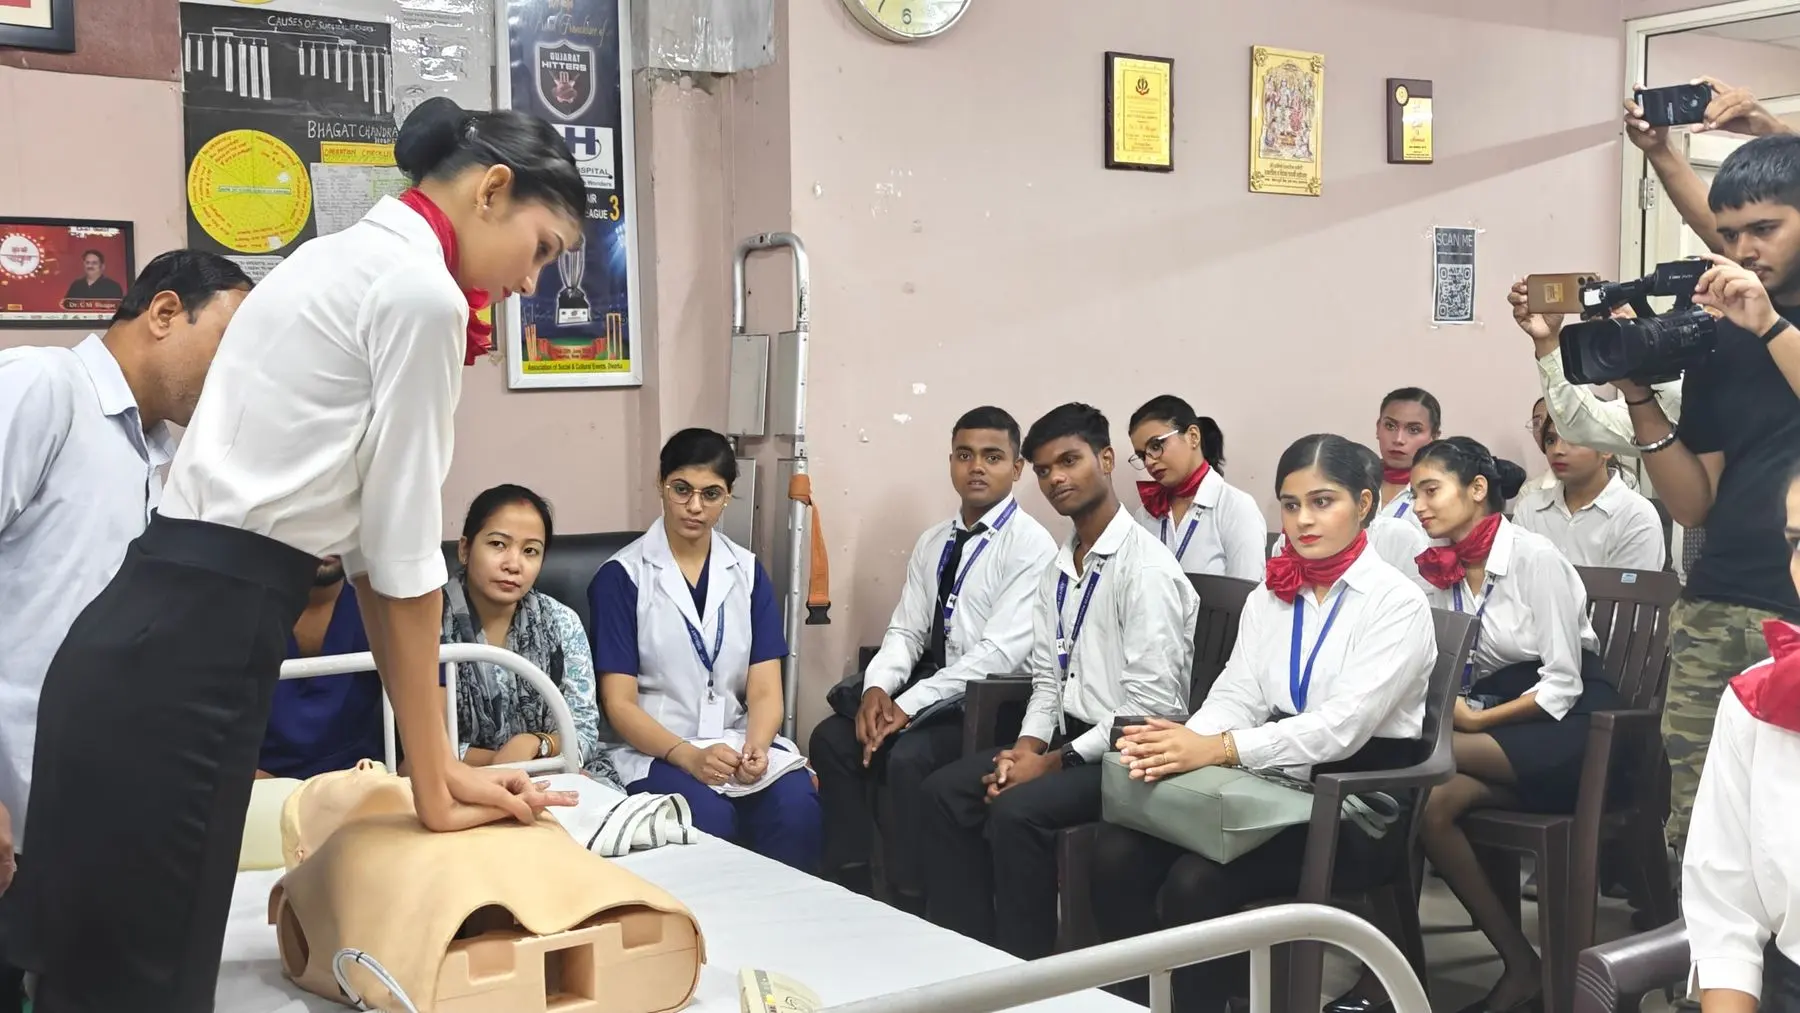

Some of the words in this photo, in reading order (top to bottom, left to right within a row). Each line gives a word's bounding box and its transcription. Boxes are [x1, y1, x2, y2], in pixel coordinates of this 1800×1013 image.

[267, 15, 303, 27] CAUSES
[304, 19, 317, 29] OF
[902, 8, 912, 25] 6
[549, 51, 581, 63] GUJARAT
[541, 60, 587, 72] HITTERS
[308, 120, 357, 139] BHAGAT
[579, 167, 610, 176] SPITAL
[609, 194, 620, 221] 3
[1436, 233, 1460, 247] SCAN
[1462, 234, 1473, 248] ME
